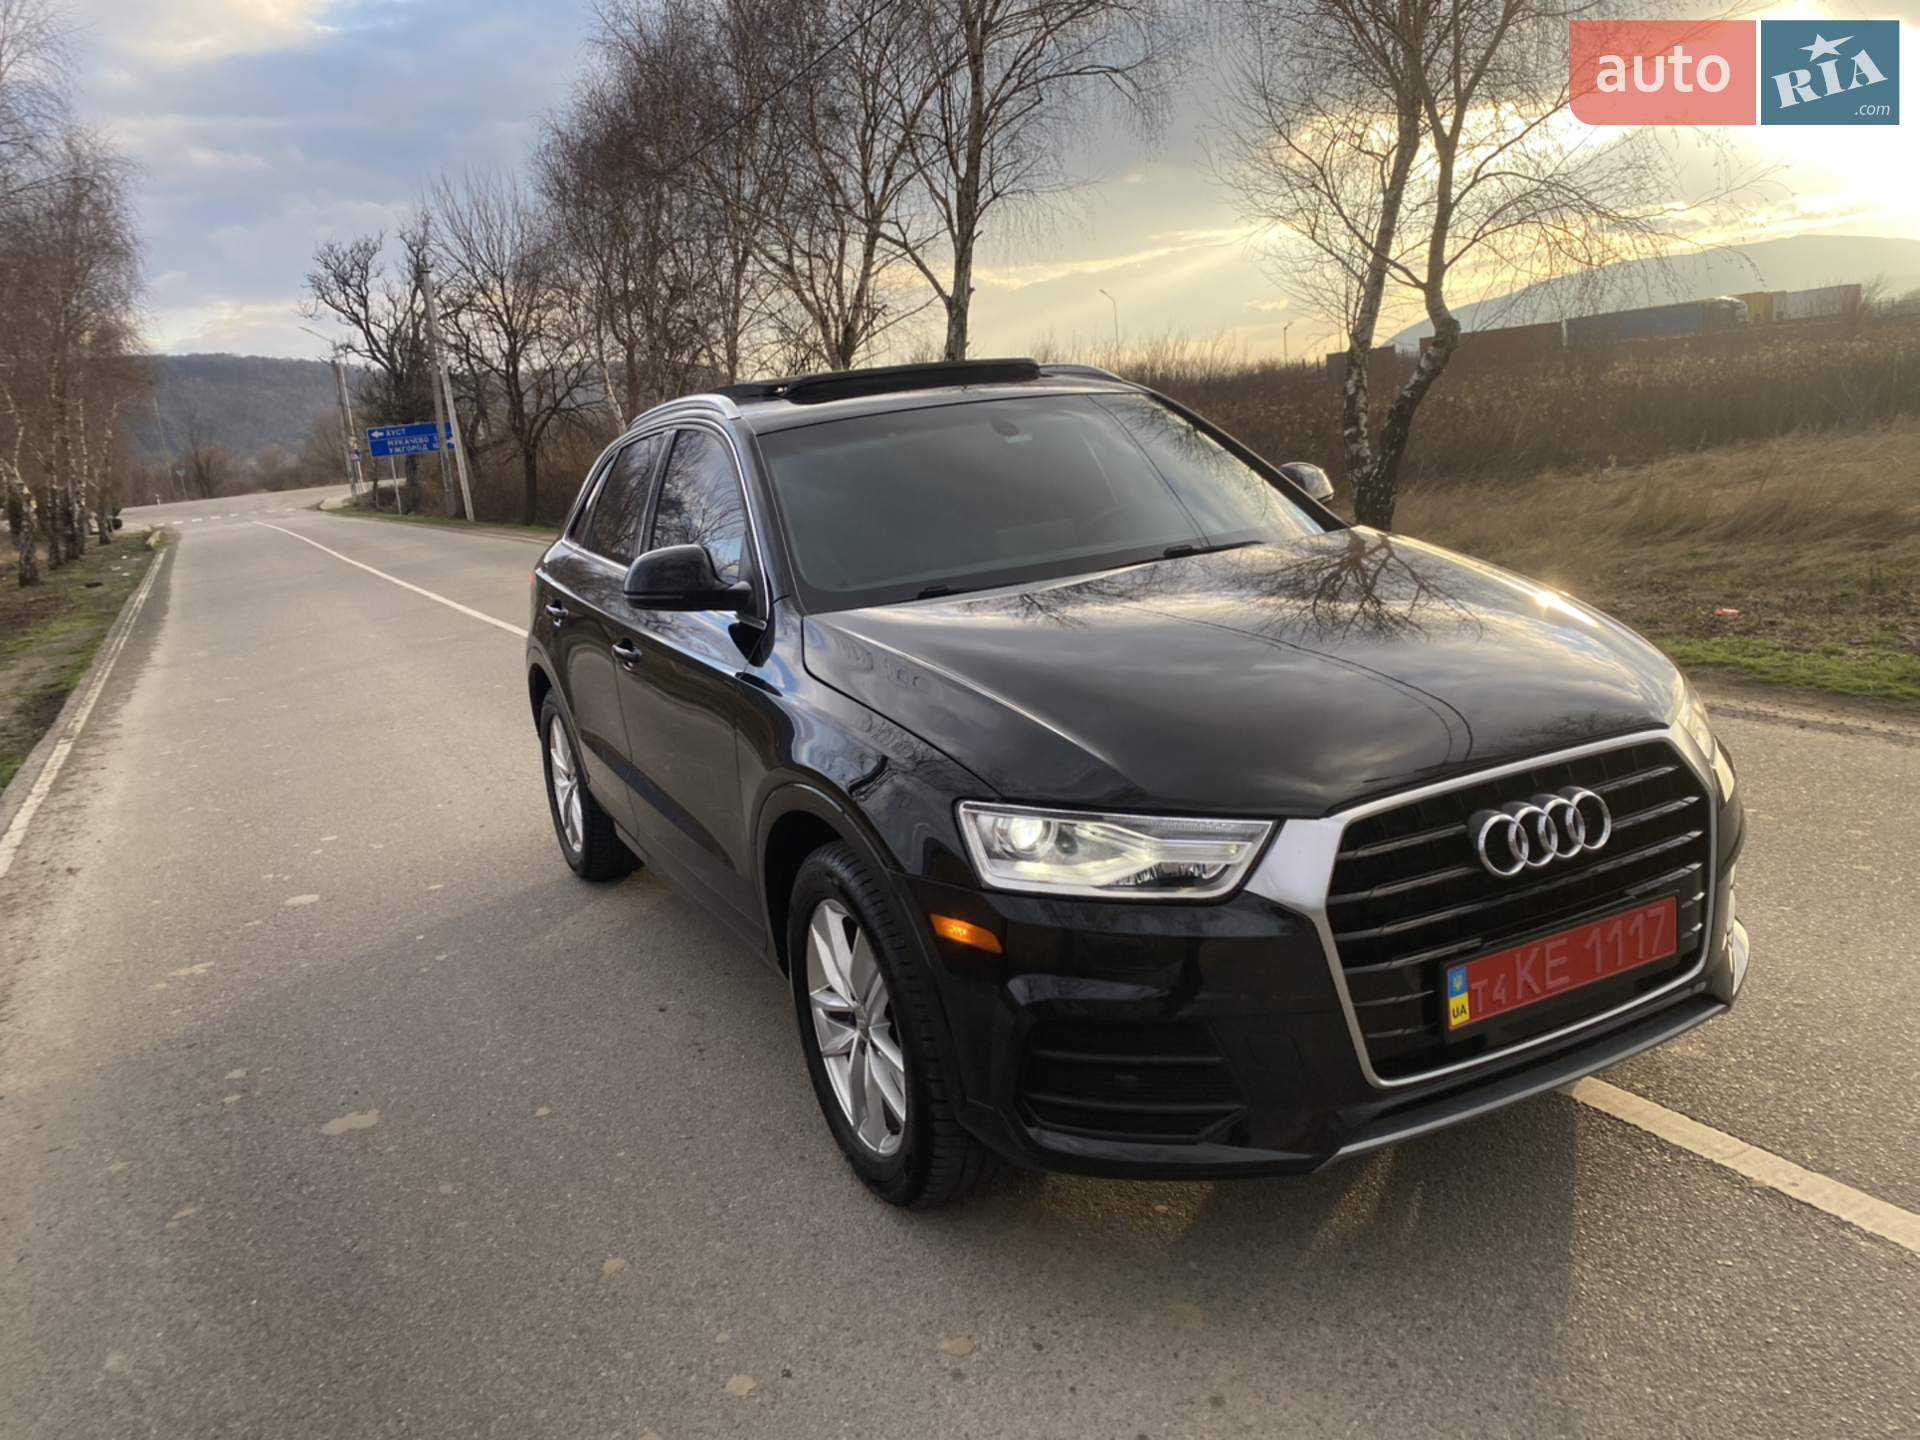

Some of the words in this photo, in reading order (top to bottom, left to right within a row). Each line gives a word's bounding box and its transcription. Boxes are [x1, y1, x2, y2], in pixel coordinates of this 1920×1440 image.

[385, 428, 406, 437] ХУСТ
[387, 436, 429, 446] МУКАЧЕВО
[388, 444, 428, 454] УЖГОРОД
[1584, 905, 1666, 974] 1117
[1452, 1004, 1467, 1018] UA
